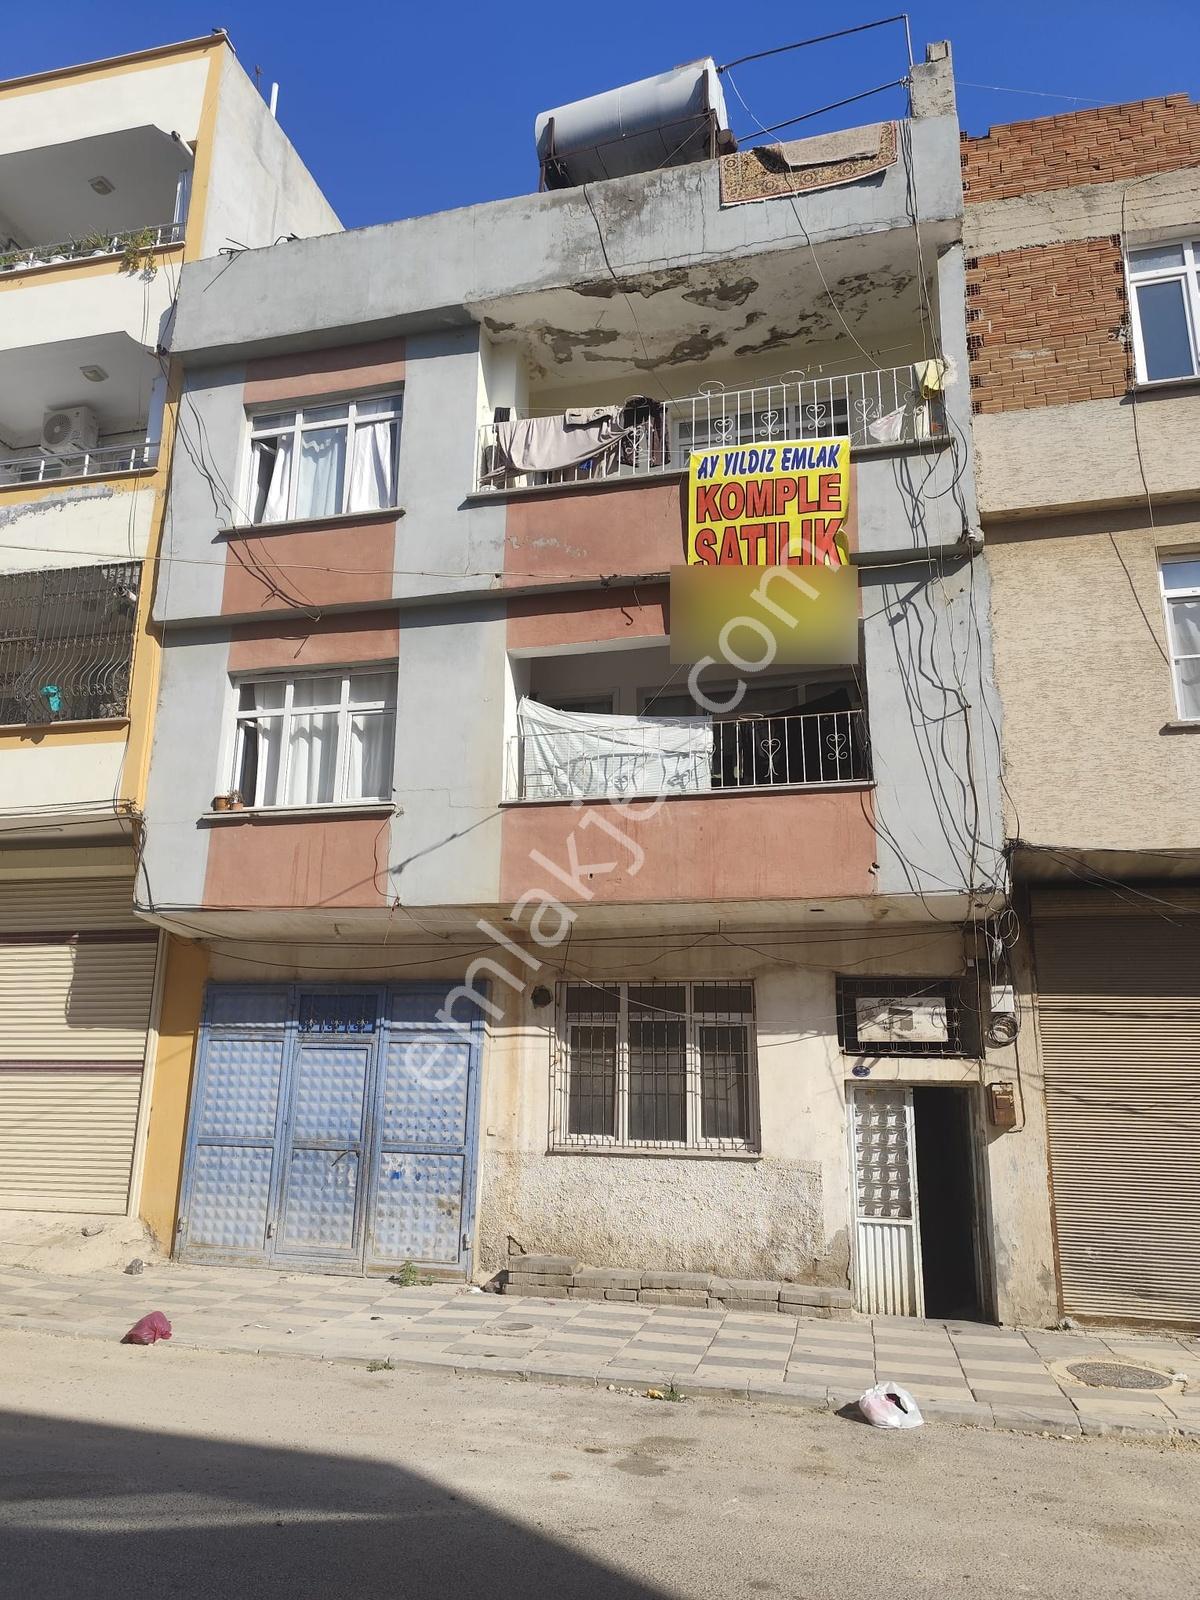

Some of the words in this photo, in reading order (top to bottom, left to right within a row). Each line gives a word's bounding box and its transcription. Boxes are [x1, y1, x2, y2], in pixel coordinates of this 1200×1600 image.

[697, 454, 720, 480] AY
[723, 448, 776, 477] YILDIZ
[781, 443, 841, 472] EMLAK
[696, 473, 842, 524] KOMPLE
[694, 517, 845, 566] SATILIK
